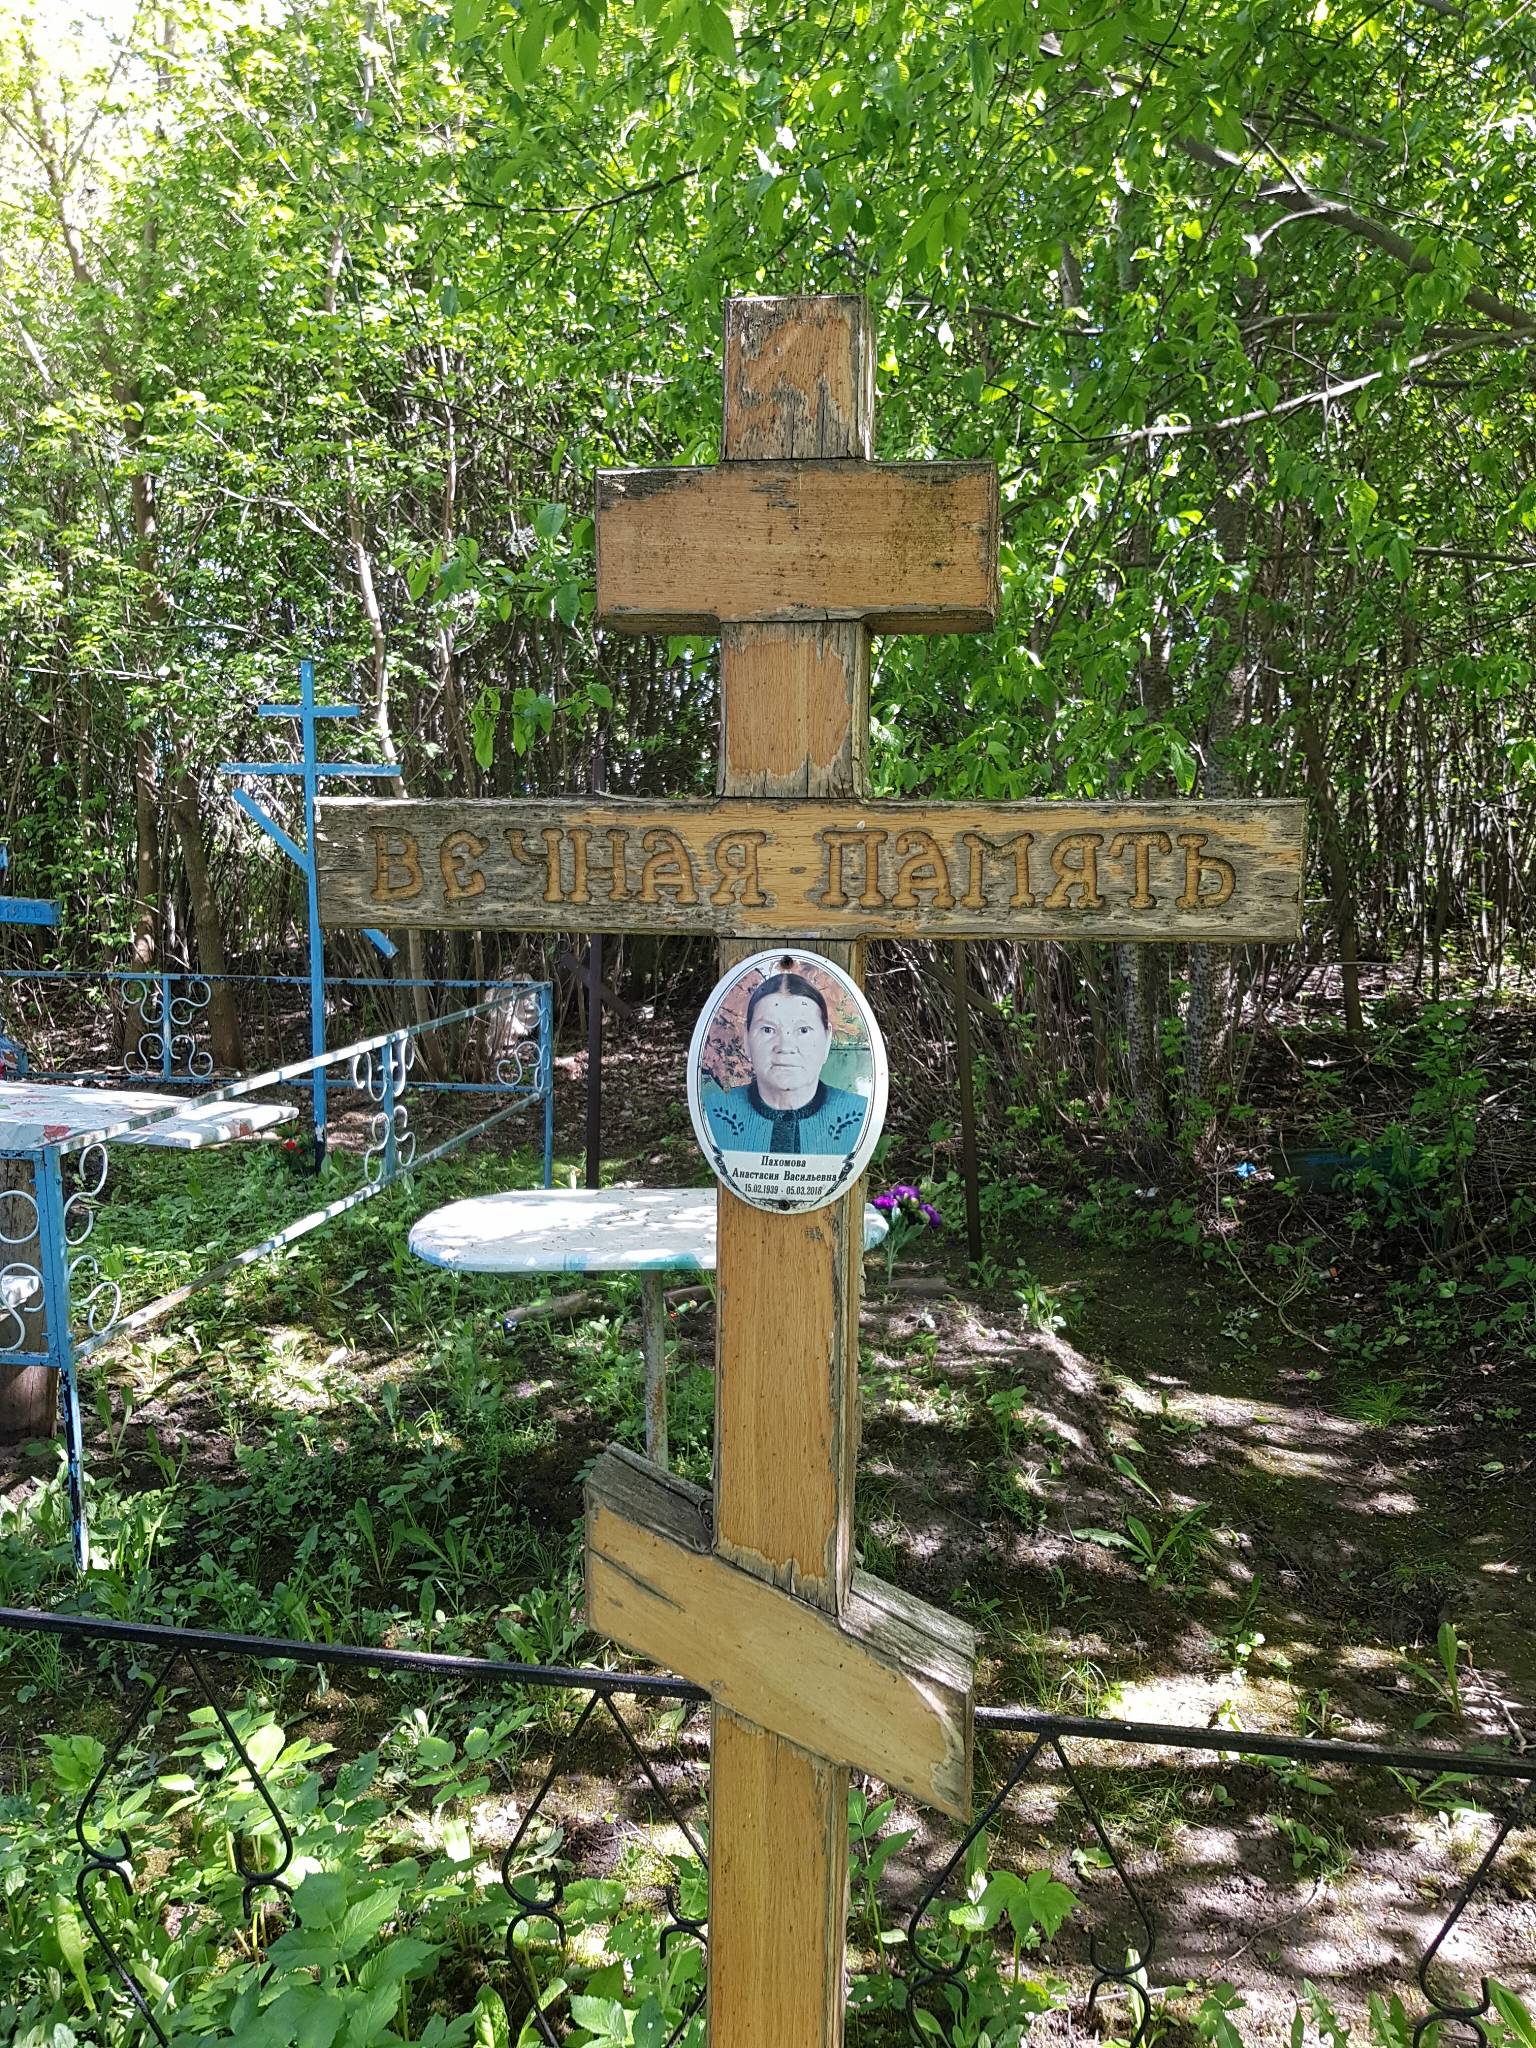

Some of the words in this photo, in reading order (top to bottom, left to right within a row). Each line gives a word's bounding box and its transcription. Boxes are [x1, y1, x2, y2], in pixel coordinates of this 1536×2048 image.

[369, 825, 767, 907] ВЕЧНАЯ
[819, 829, 1237, 909] ПАМЯТЬ
[760, 1155, 807, 1168] Пахомова
[732, 1168, 779, 1181] Анастасия
[783, 1170, 837, 1182] Васильевна
[744, 1183, 778, 1194] 15.02.1939
